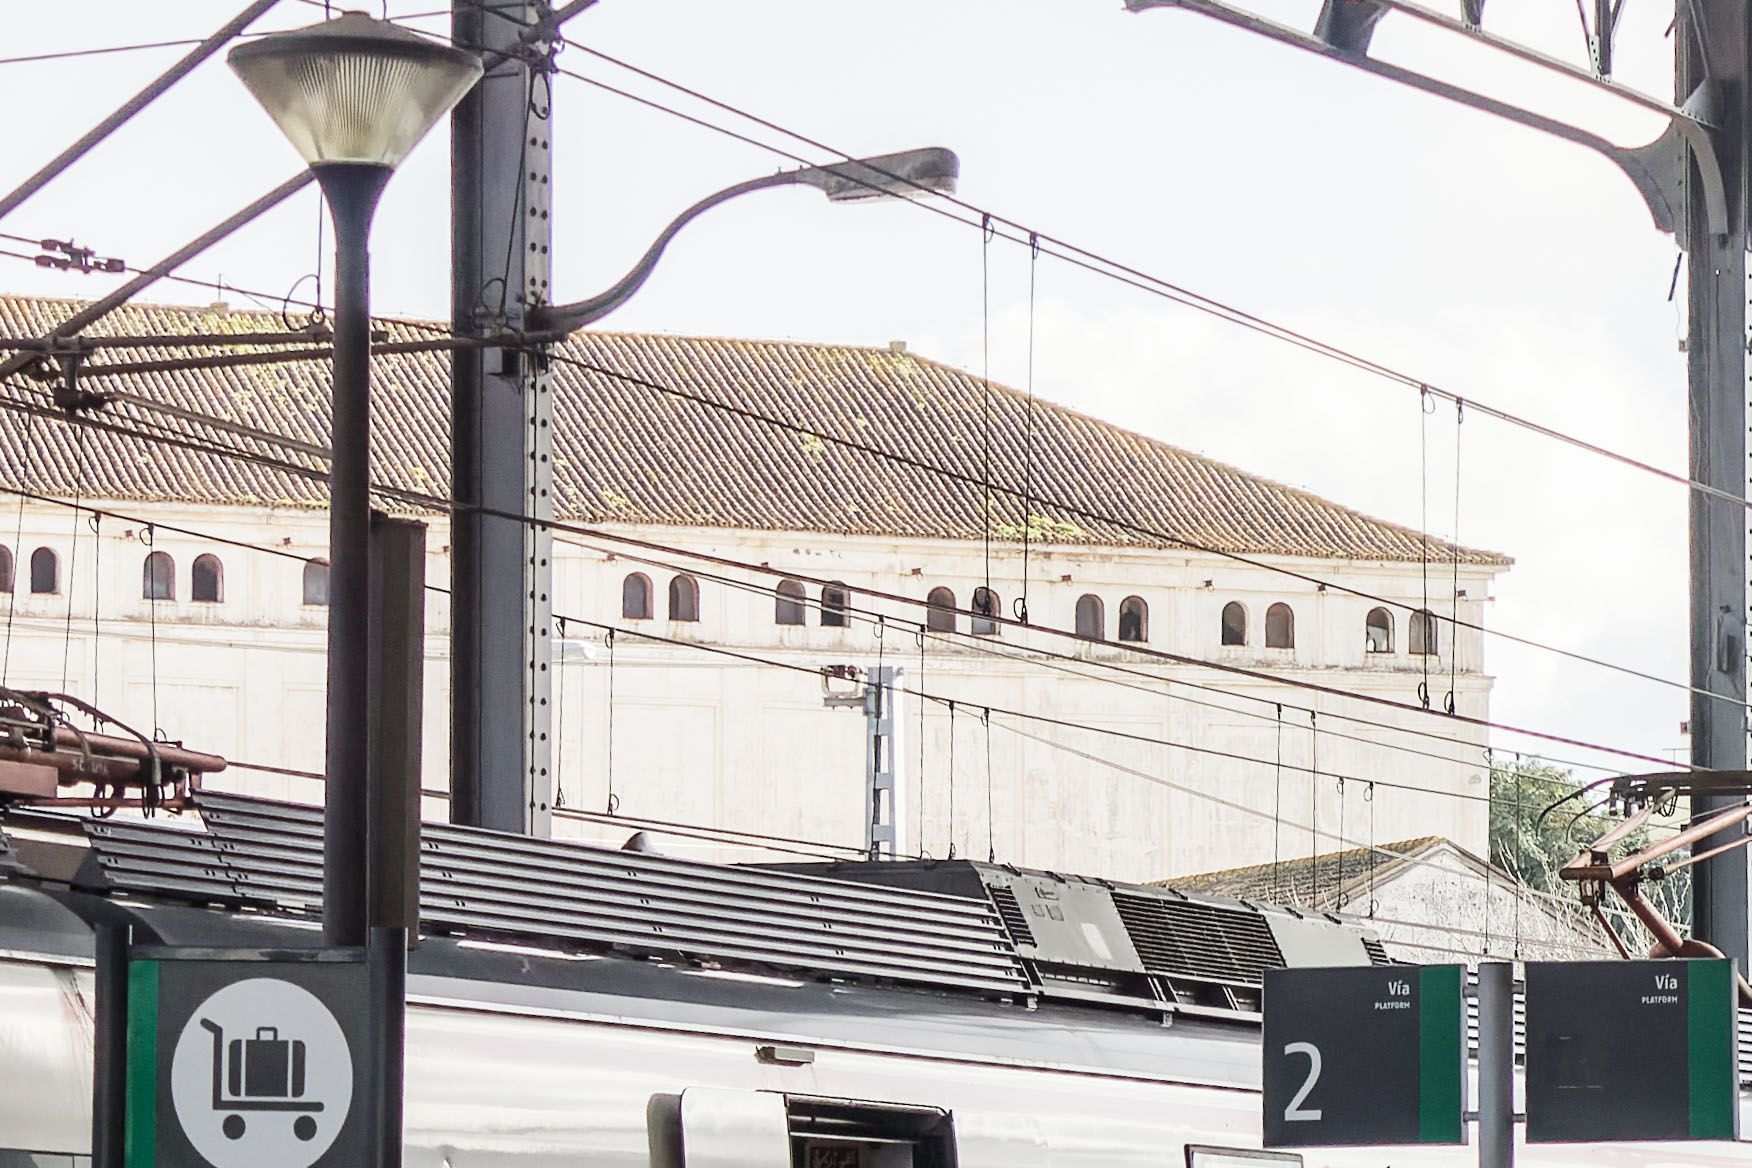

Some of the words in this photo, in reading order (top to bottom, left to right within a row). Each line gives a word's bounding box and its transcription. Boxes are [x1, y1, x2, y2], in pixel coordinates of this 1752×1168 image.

[1388, 979, 1410, 996] Vía
[1655, 973, 1678, 990] Vía
[1374, 1001, 1411, 1011] PLATFORM
[1641, 995, 1678, 1005] PLATFORM
[1284, 1042, 1322, 1121] 2
